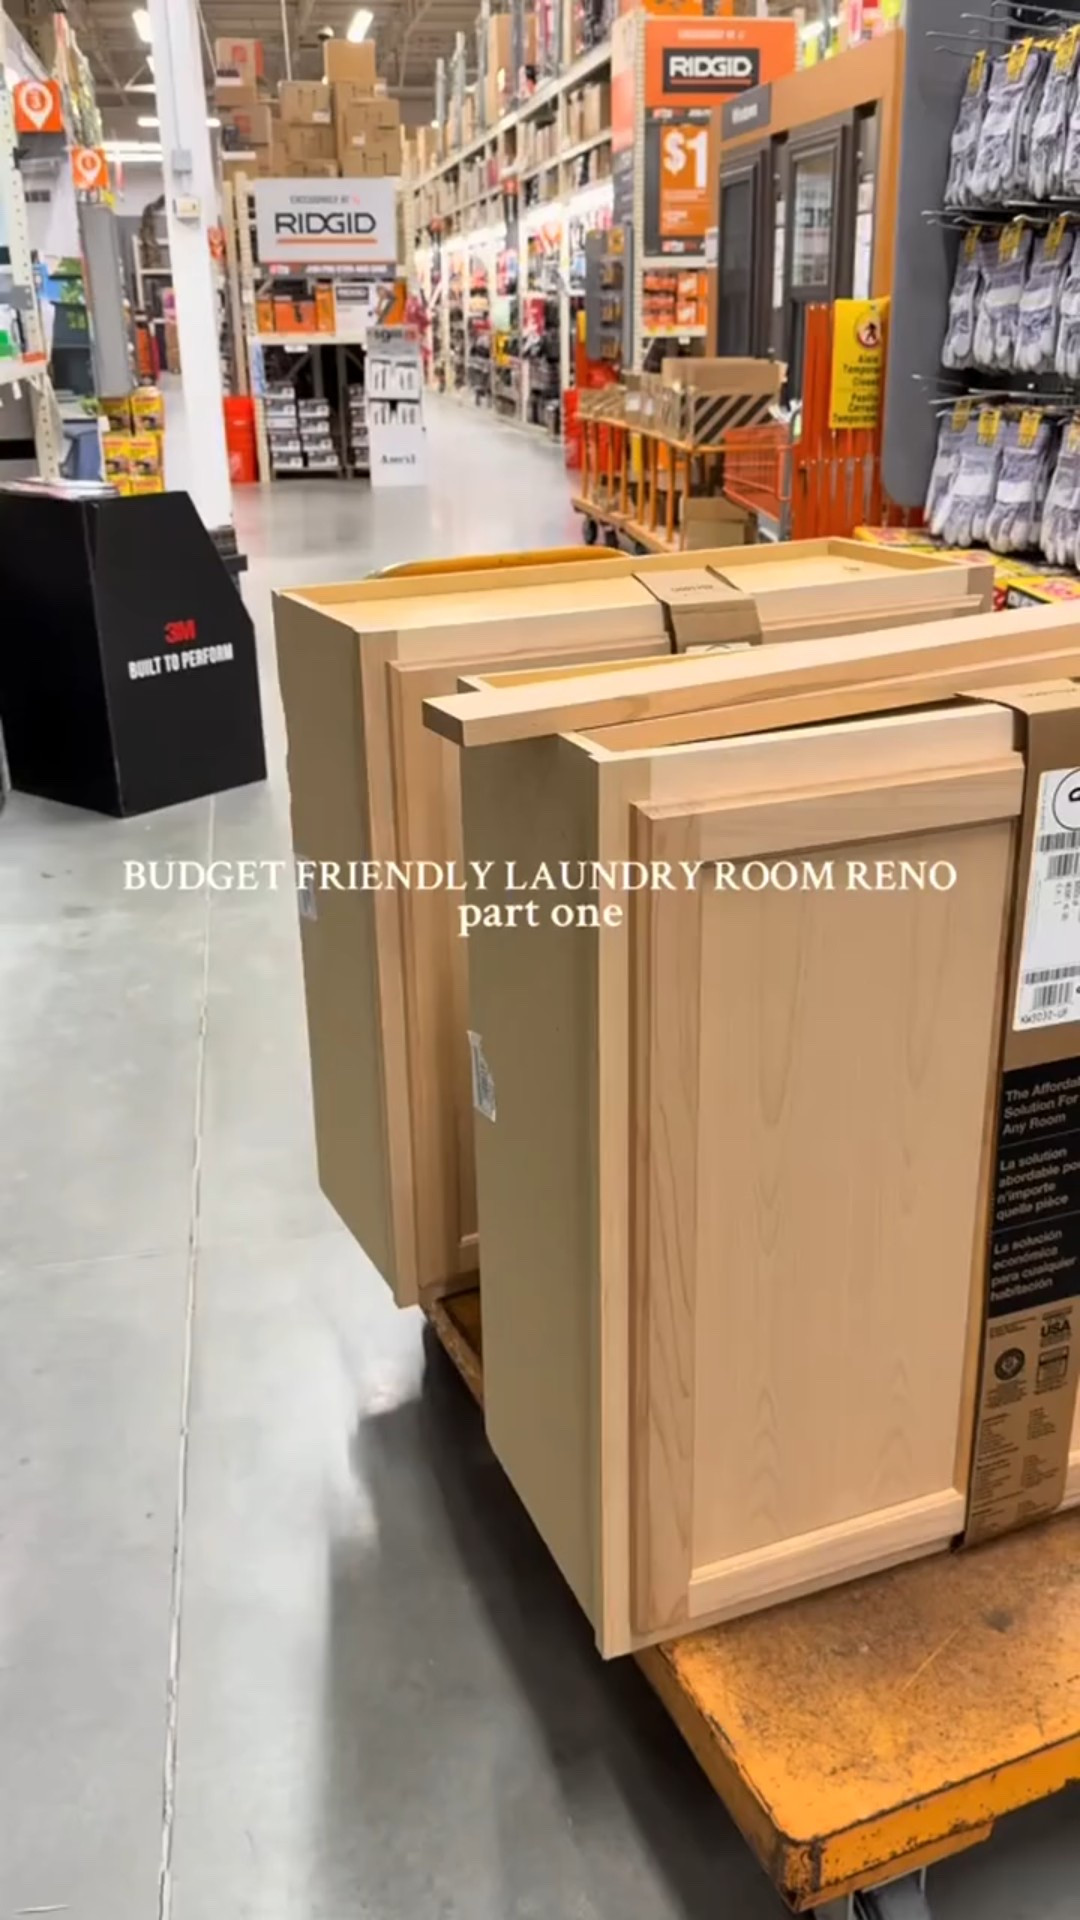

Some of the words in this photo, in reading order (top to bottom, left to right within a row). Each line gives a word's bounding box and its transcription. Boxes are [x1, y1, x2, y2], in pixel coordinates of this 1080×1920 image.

[669, 56, 753, 77] RIDGID
[275, 212, 376, 234] RIDGID
[165, 620, 197, 643] 3M
[128, 656, 162, 680] BUILT
[164, 653, 180, 672] TO
[181, 642, 234, 669] PERFORM
[1004, 1100, 1055, 1119] Solution
[1058, 1094, 1079, 1107] For
[1005, 1089, 1029, 1102] The
[1002, 1122, 1027, 1136] Any
[1029, 1113, 1066, 1129] Room
[1000, 1160, 1015, 1171] La
[1018, 1148, 1067, 1167] solution
[999, 1166, 1060, 1188] abordable
[996, 1203, 1033, 1221] quelle
[994, 1243, 1009, 1255] La
[1012, 1230, 1062, 1250] solución
[991, 1272, 1019, 1289] para
[1021, 1256, 1077, 1278] cualquier
[1041, 1319, 1071, 1337] USA
